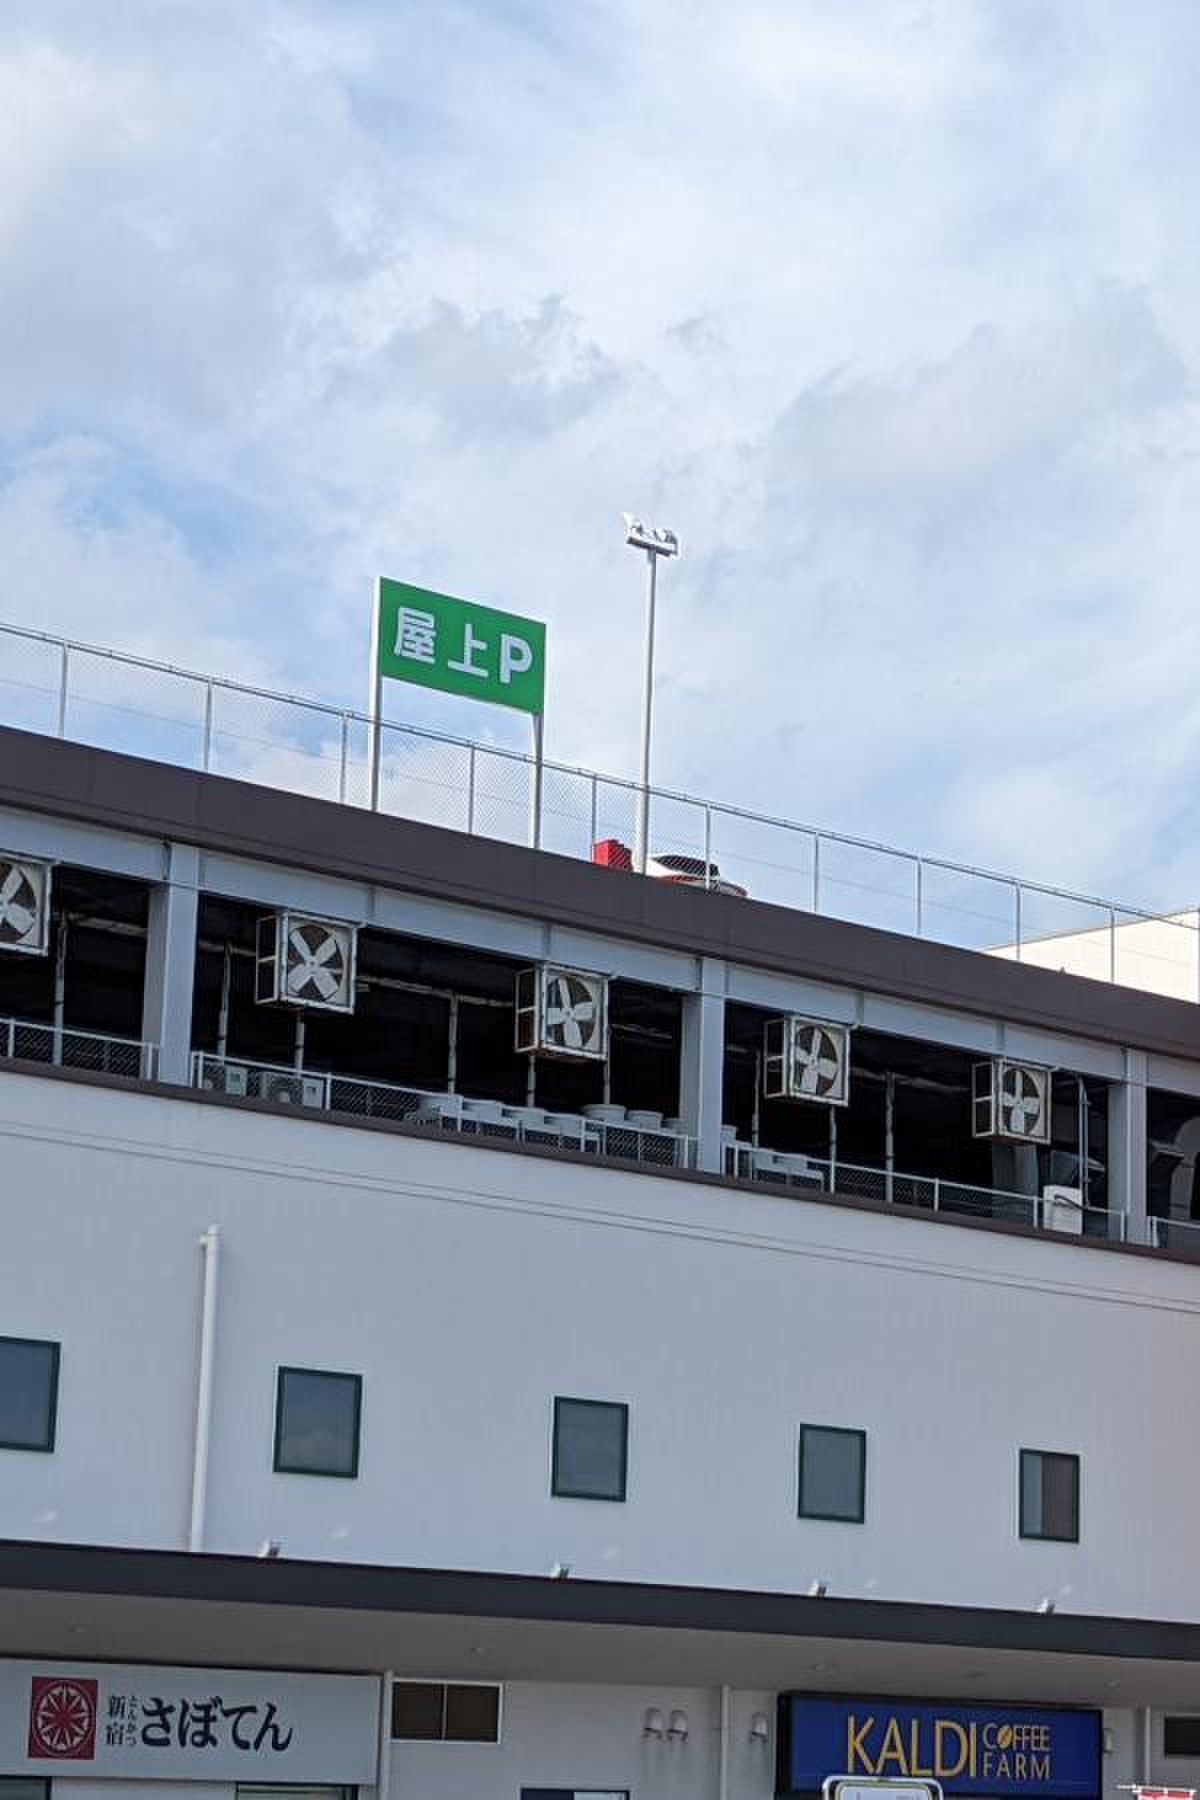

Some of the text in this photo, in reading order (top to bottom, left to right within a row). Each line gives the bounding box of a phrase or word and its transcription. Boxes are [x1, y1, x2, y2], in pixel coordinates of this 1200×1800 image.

[394, 607, 533, 684] 屋上P
[106, 1695, 126, 1747] 新宿
[141, 1696, 293, 1751] さぼてん
[847, 1715, 977, 1778] KALDI
[982, 1723, 1051, 1752] COFFEE
[982, 1752, 1051, 1780] FARM
